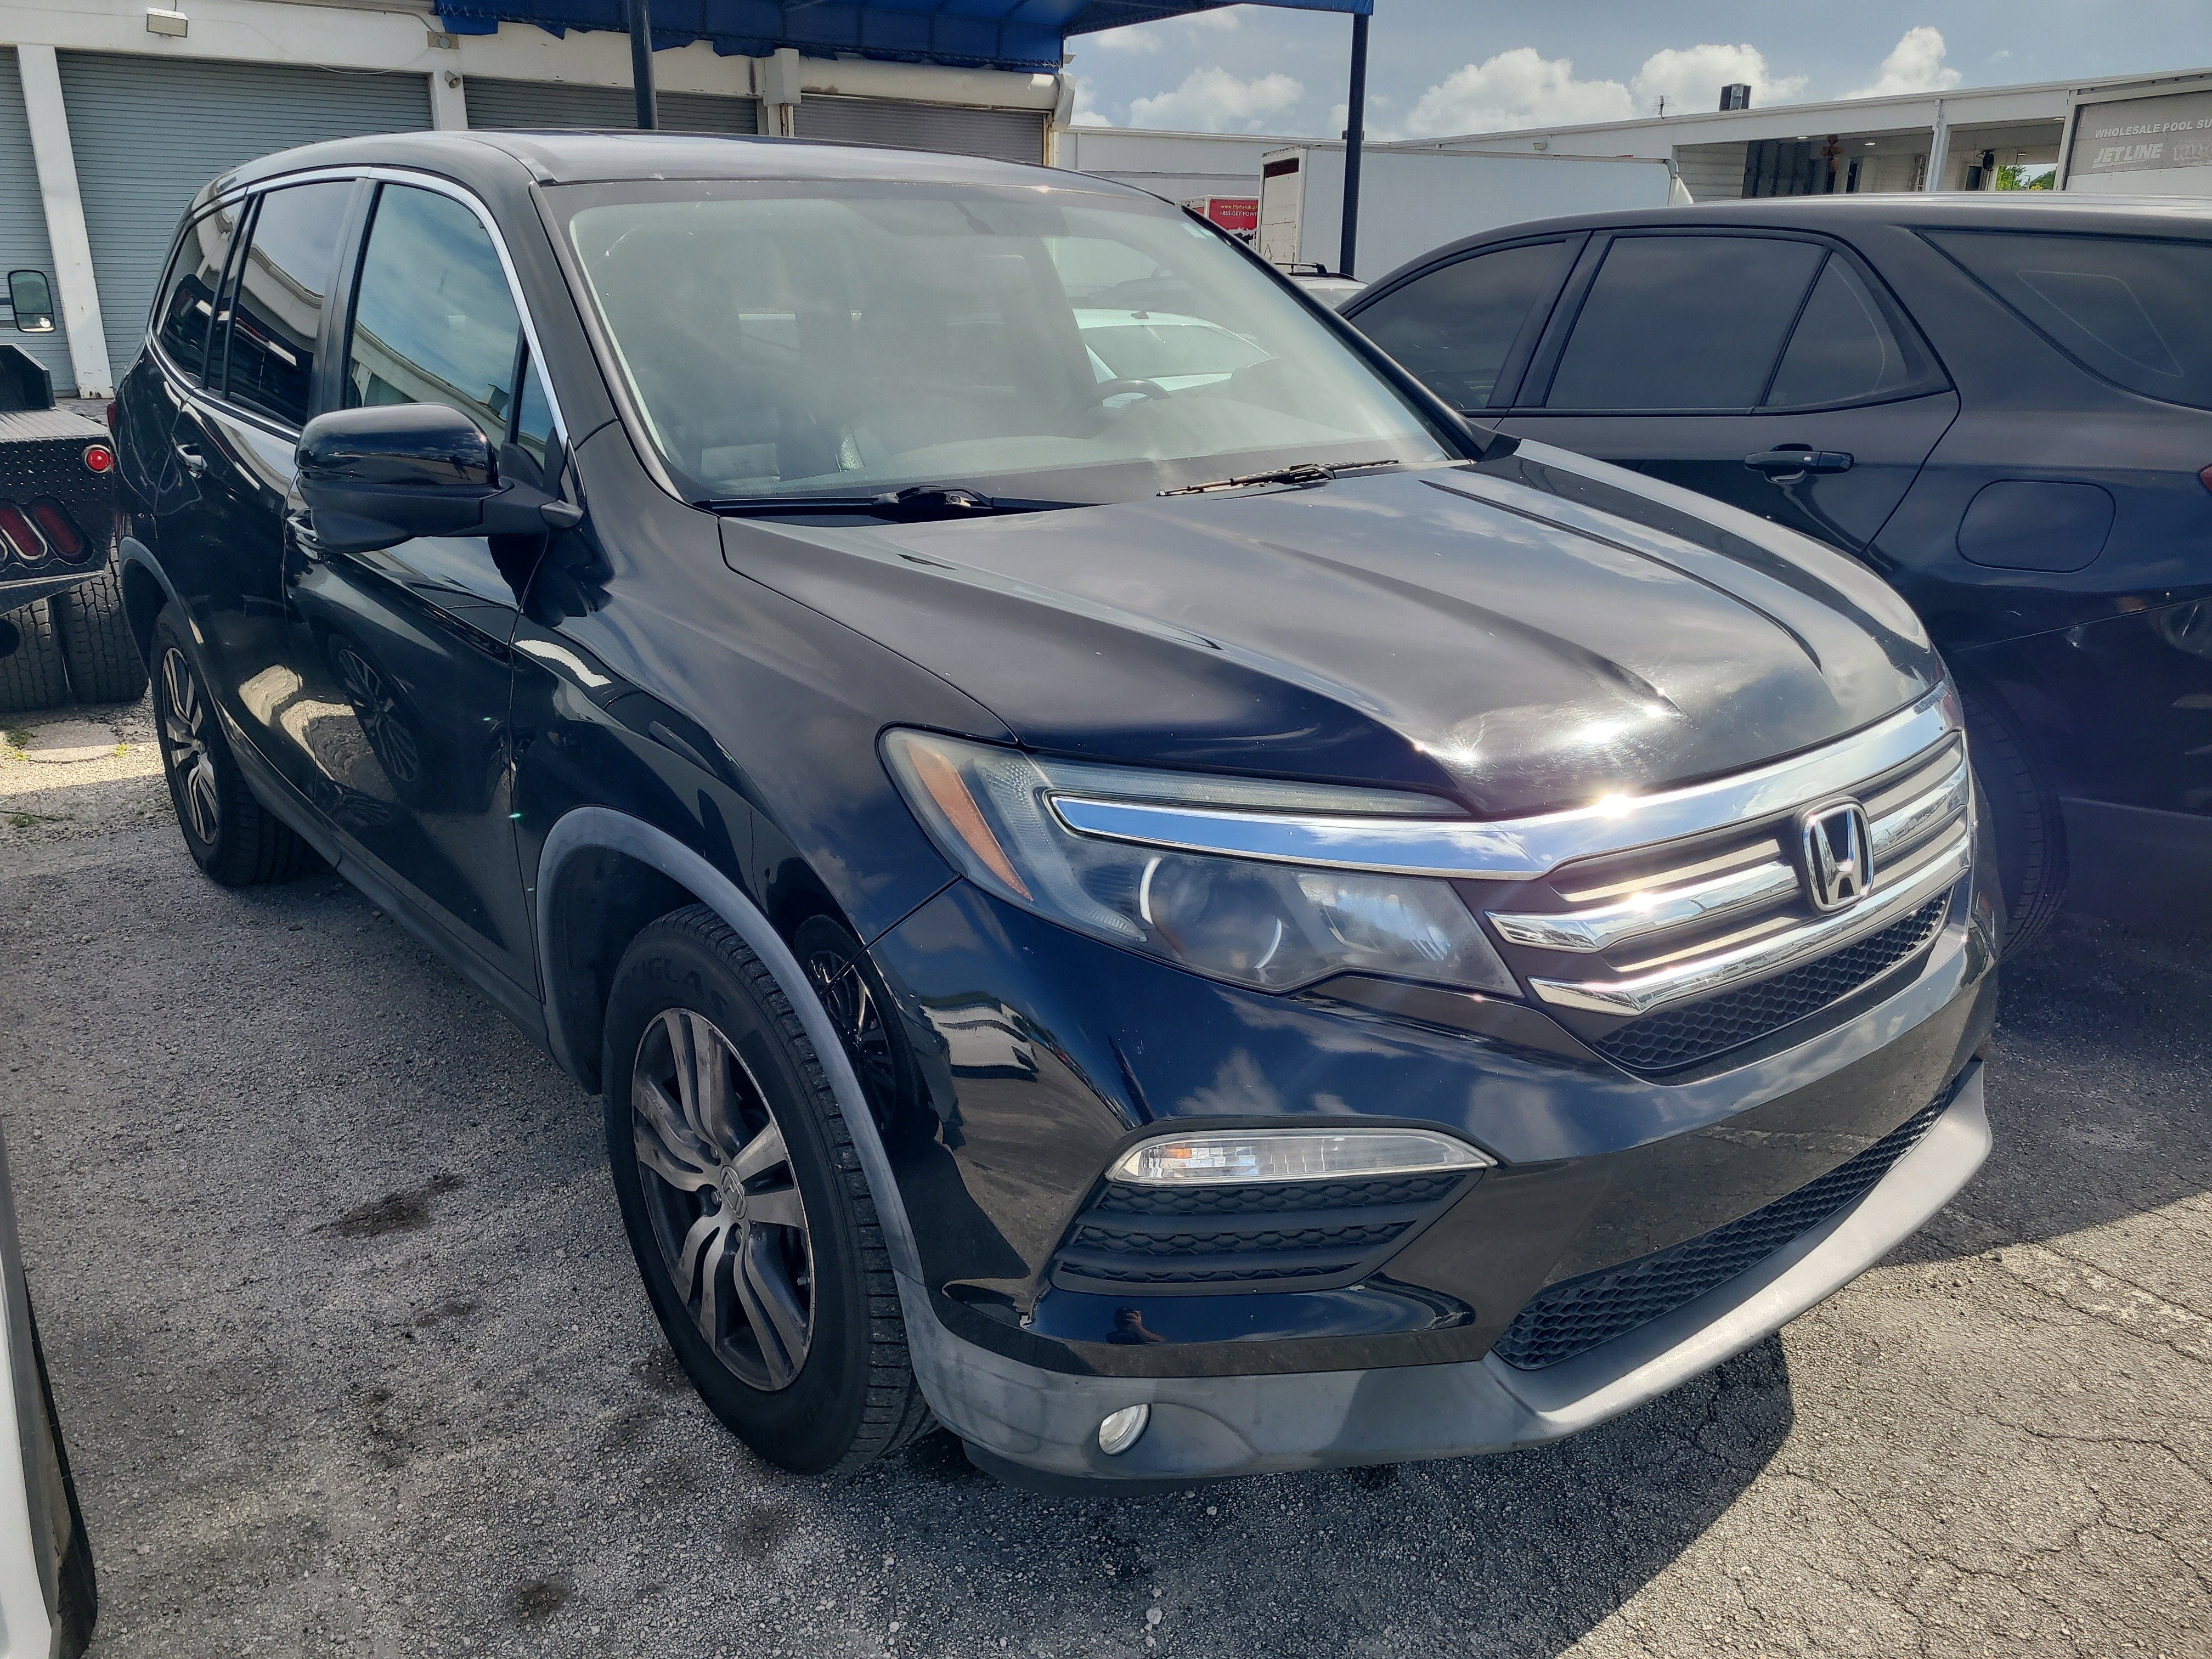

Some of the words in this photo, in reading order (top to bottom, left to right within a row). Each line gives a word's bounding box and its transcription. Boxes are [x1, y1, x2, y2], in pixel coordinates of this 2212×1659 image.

[2095, 123, 2160, 138] WHOLESALE
[2163, 121, 2193, 132] POOL
[2094, 143, 2164, 163] JETLINE
